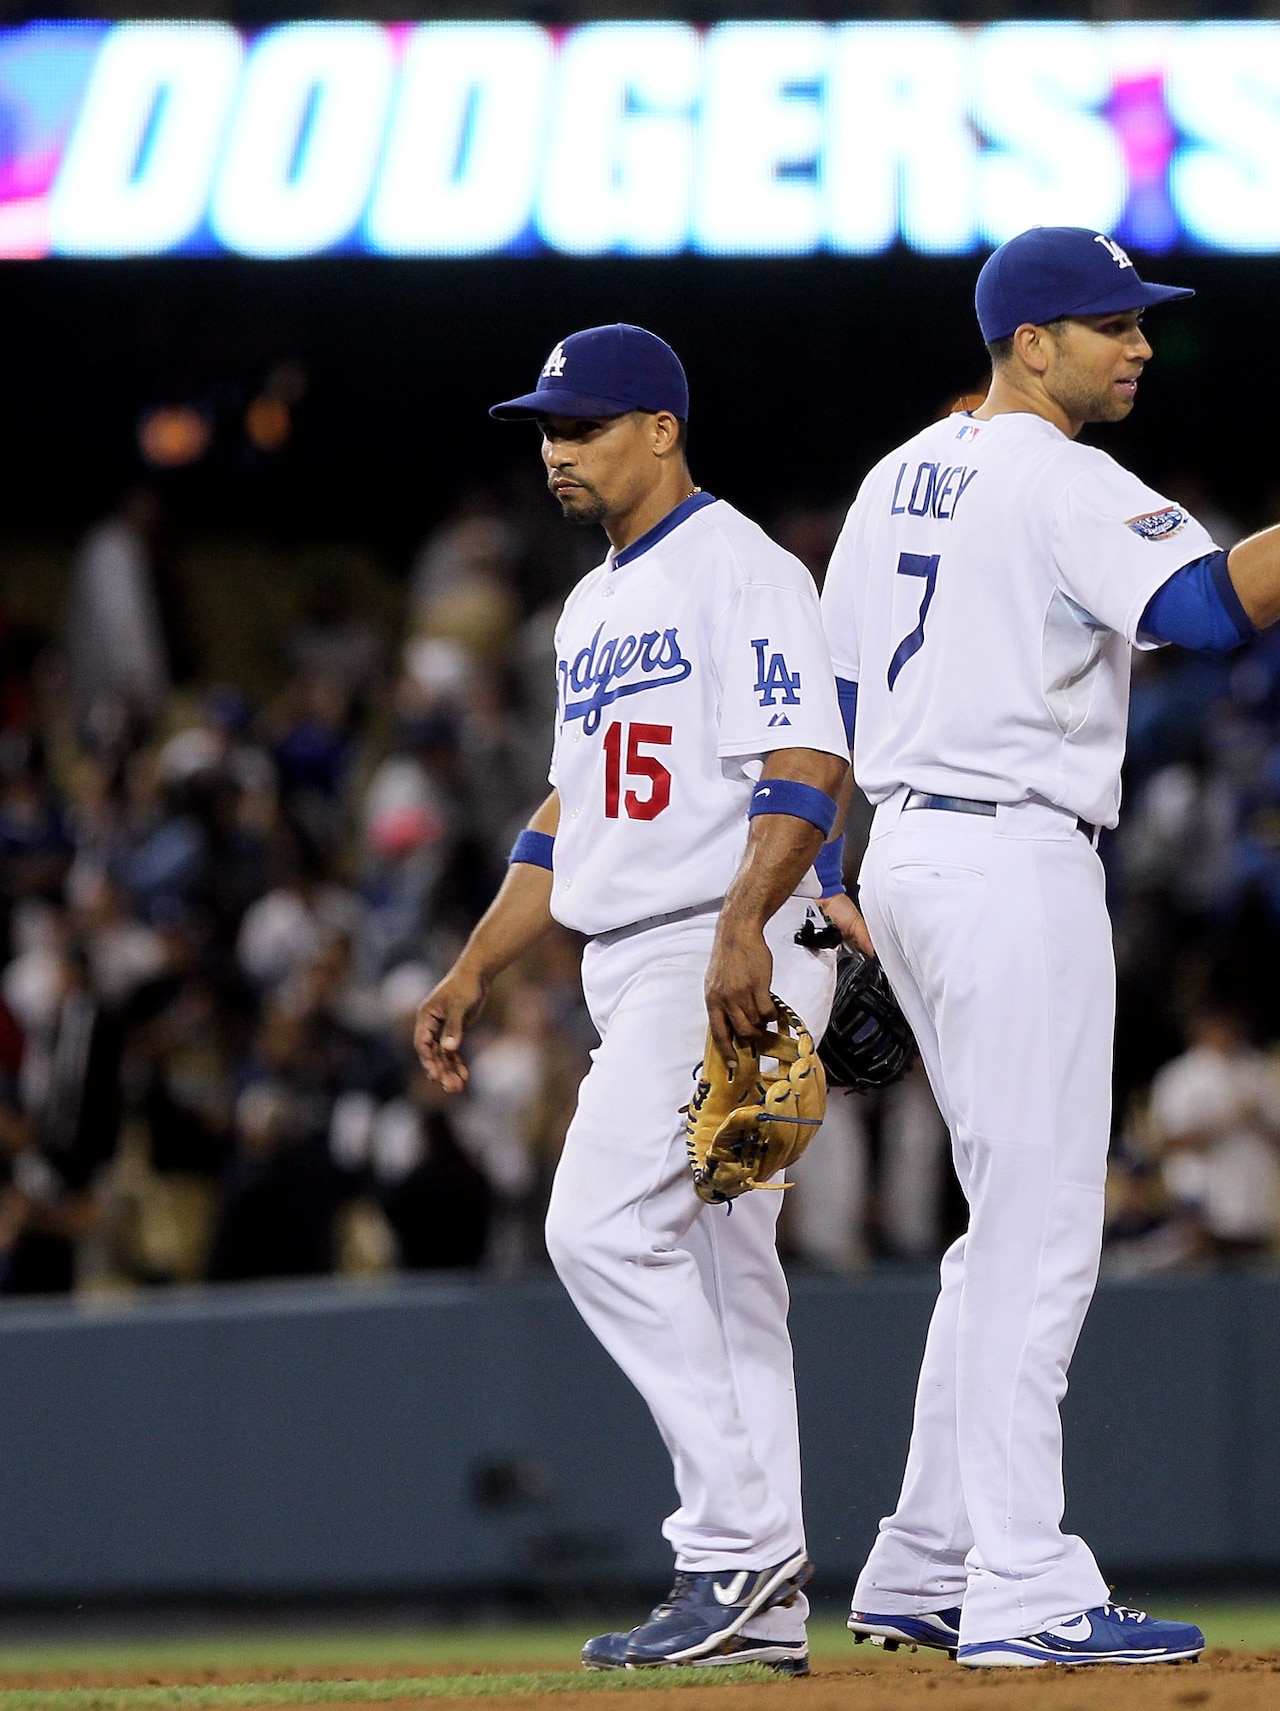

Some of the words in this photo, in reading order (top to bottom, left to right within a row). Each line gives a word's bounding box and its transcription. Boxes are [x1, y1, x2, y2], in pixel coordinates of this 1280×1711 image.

[48, 18, 1128, 258] DODGERS
[751, 638, 801, 707] LA
[887, 552, 940, 693] 7
[603, 720, 673, 822] 15
